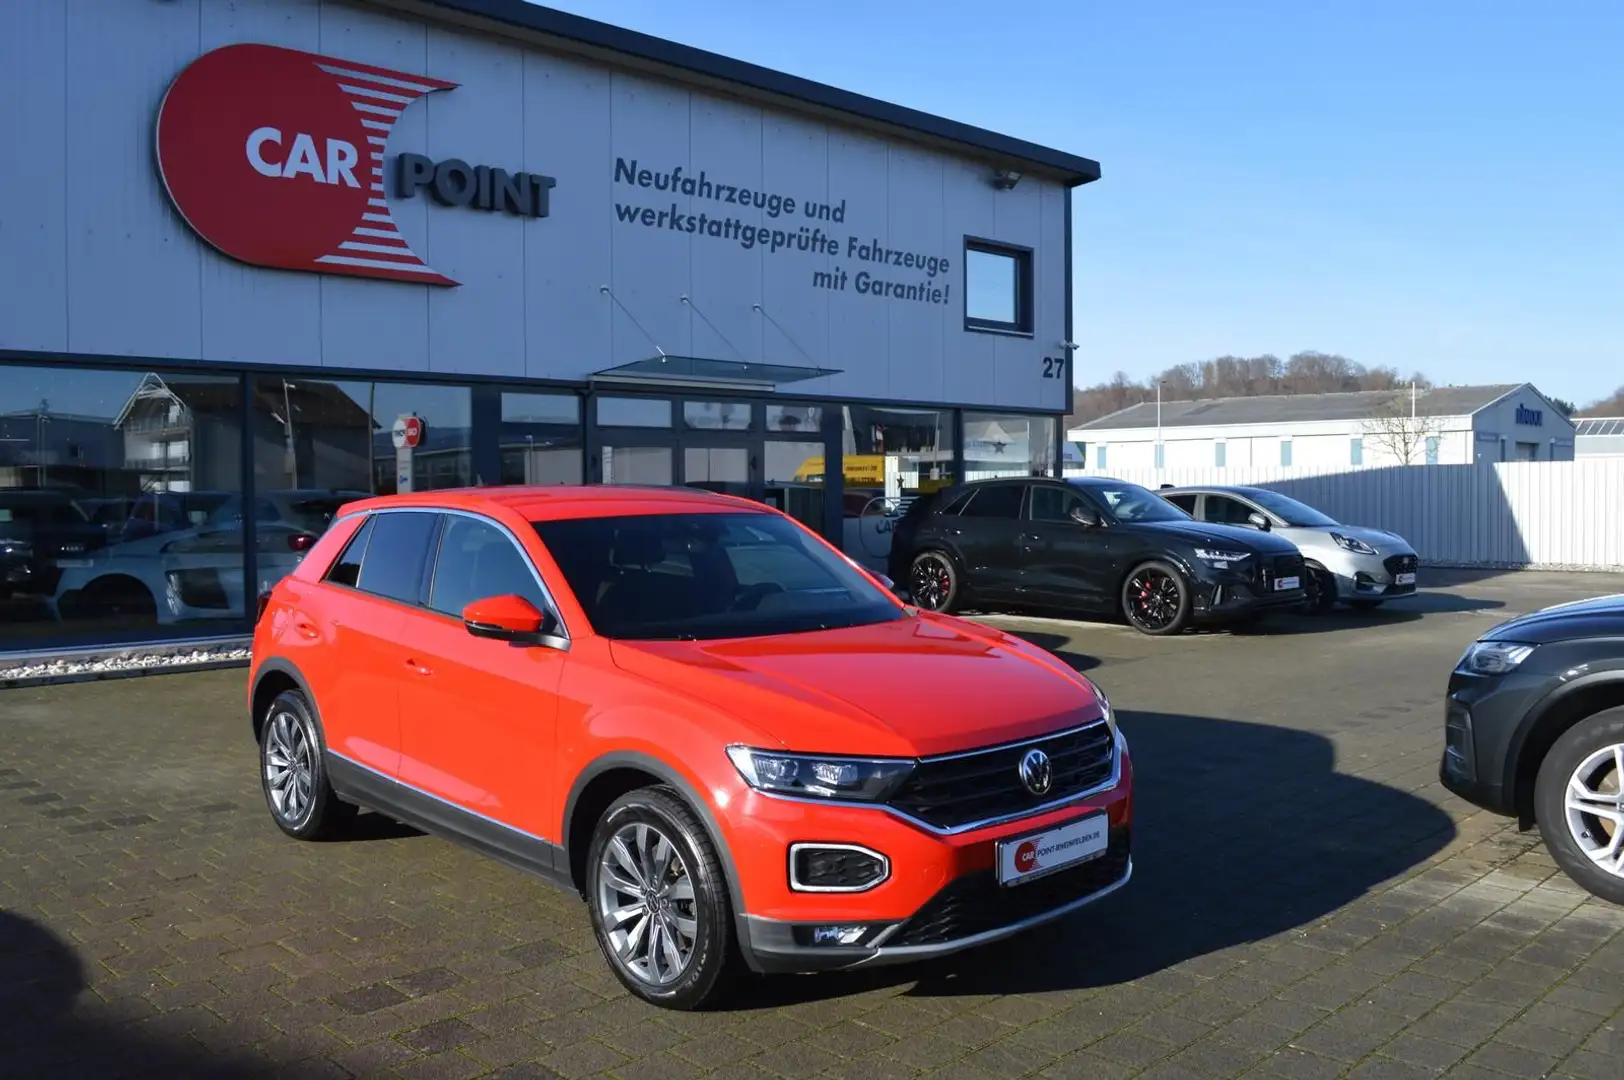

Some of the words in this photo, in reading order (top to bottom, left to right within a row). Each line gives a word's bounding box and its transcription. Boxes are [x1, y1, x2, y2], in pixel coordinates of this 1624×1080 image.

[245, 126, 362, 189] CAR
[396, 152, 557, 219] POINT
[613, 157, 796, 218] Neufahrzeuge
[804, 199, 846, 223] und
[614, 203, 839, 256] werkstattgeprüfte
[847, 236, 950, 278] Fahrzeuge
[812, 266, 848, 291] mit
[854, 271, 950, 305] Garantie!
[1042, 356, 1065, 379] 27
